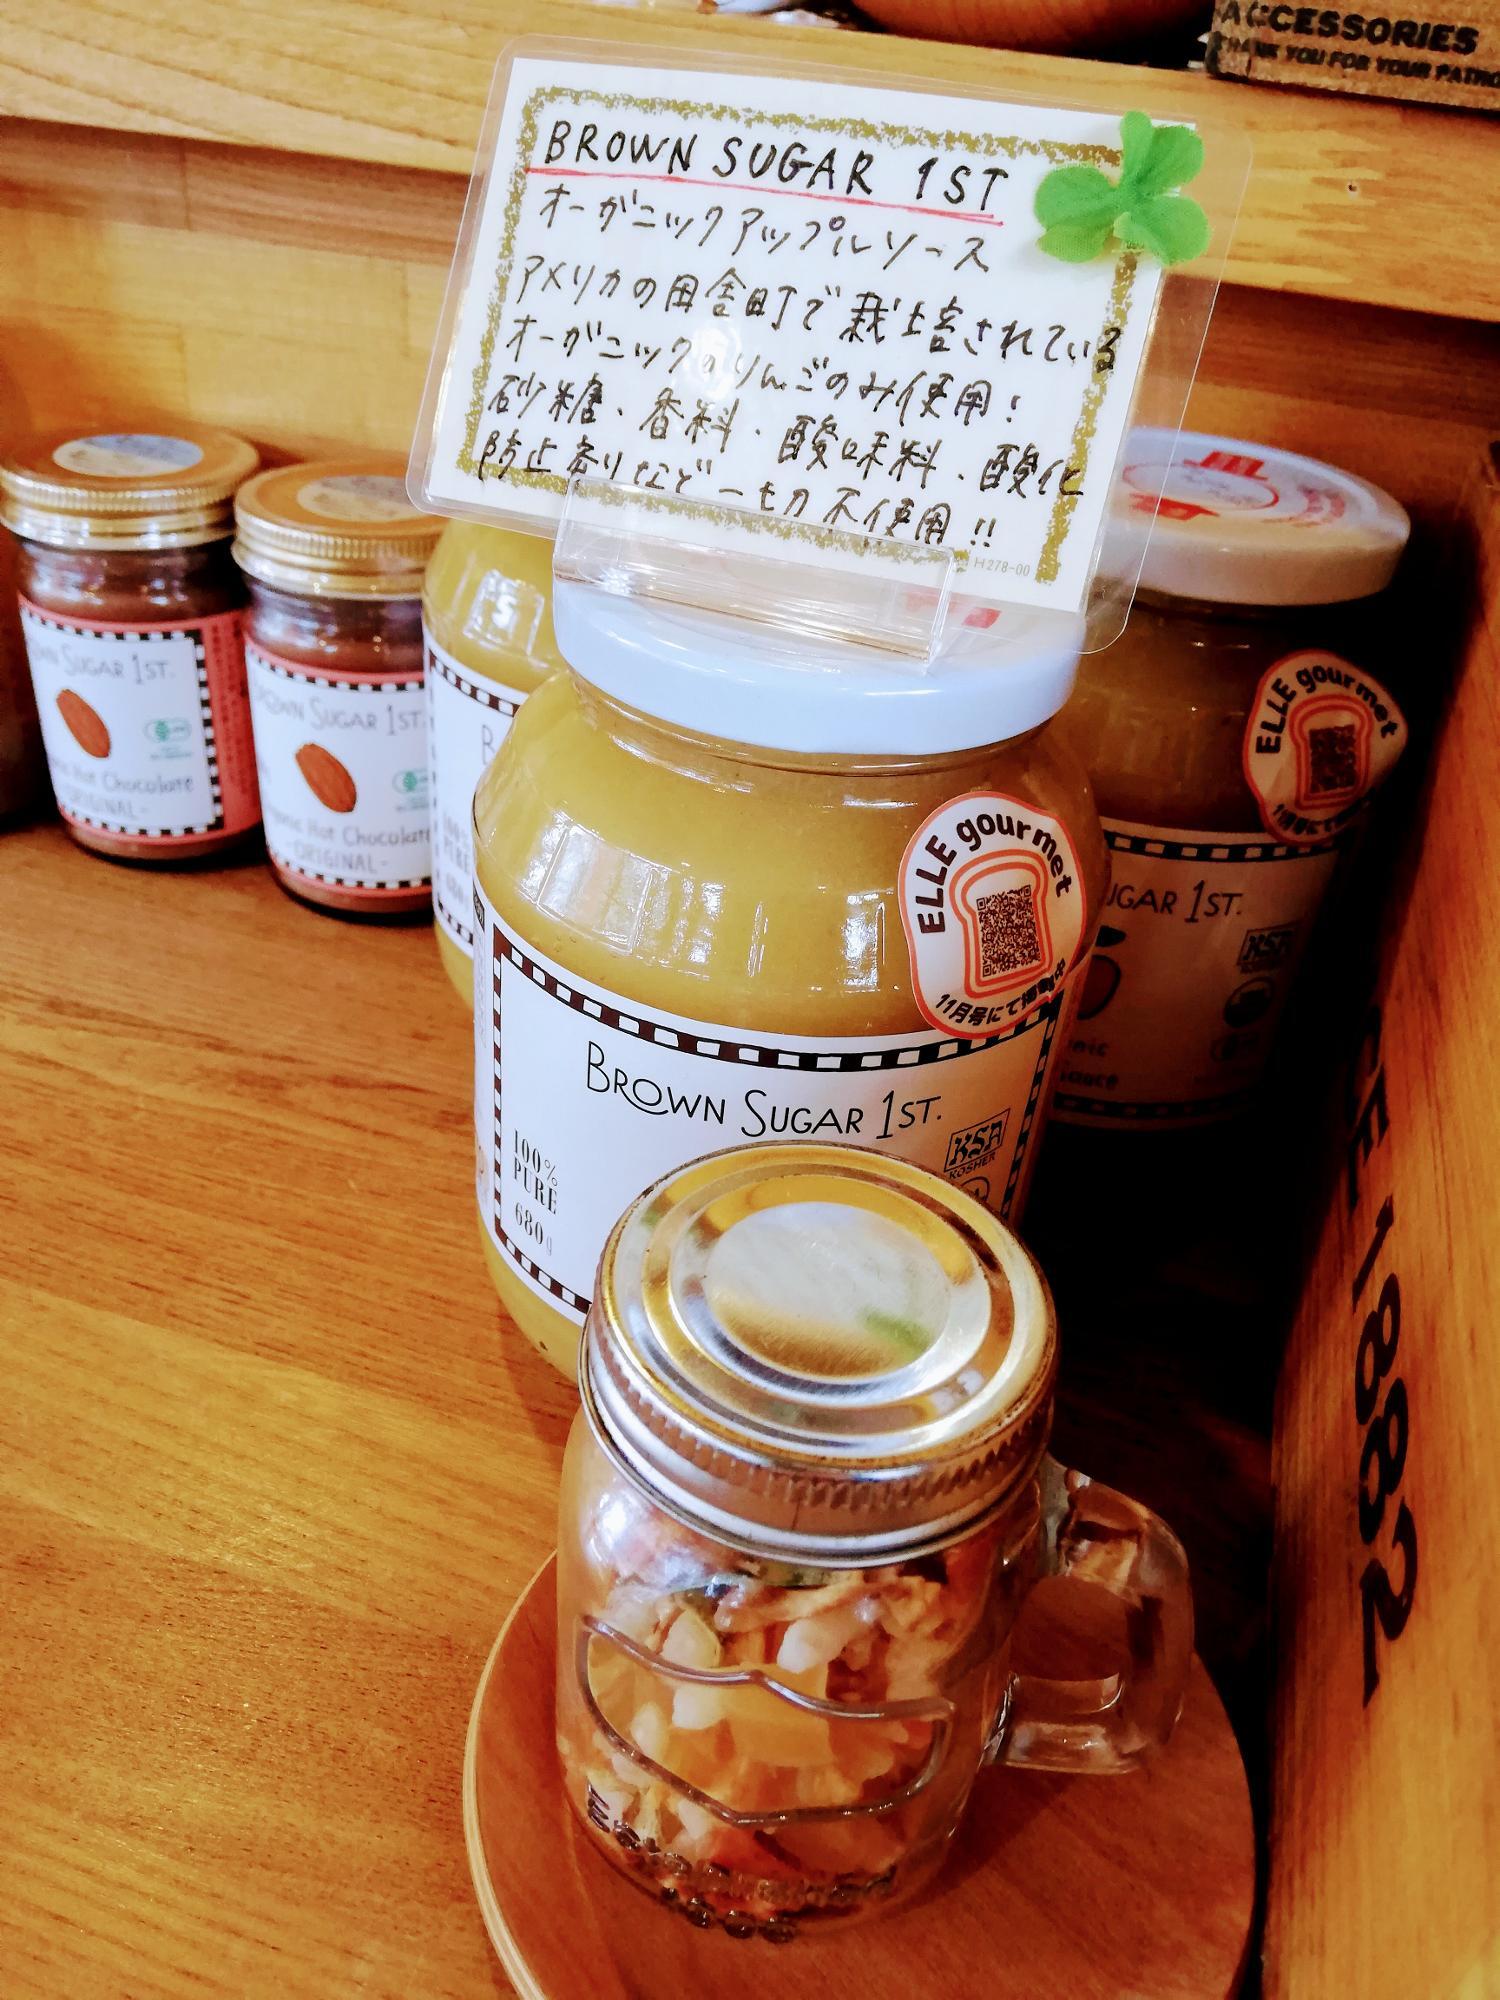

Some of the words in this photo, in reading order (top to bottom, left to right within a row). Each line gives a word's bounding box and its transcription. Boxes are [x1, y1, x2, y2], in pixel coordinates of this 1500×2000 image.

[1219, 0, 1480, 55] ACCESSORIES
[1286, 45, 1326, 66] YOU
[1329, 50, 1371, 72] FOR
[1376, 55, 1433, 79] YOUR
[544, 121, 698, 175] BROWN
[712, 136, 876, 196] SUGAR
[916, 156, 1009, 211] 1ST
[974, 556, 1031, 577] H278-00
[308, 696, 378, 731] SUGAR
[1256, 677, 1297, 754] ELLE
[1296, 665, 1398, 739] gourmet
[915, 834, 957, 934] ELLE
[956, 813, 1073, 898] gourmet
[586, 1041, 726, 1125] BROWN
[741, 1089, 864, 1138] SUGAR
[875, 1090, 943, 1141] 1ST.
[513, 1128, 559, 1187] 100%
[949, 1120, 1003, 1167] KSA
[949, 1152, 996, 1179] KOSHER
[513, 1155, 559, 1215] PURE
[1353, 1195, 1418, 1709] 1882
